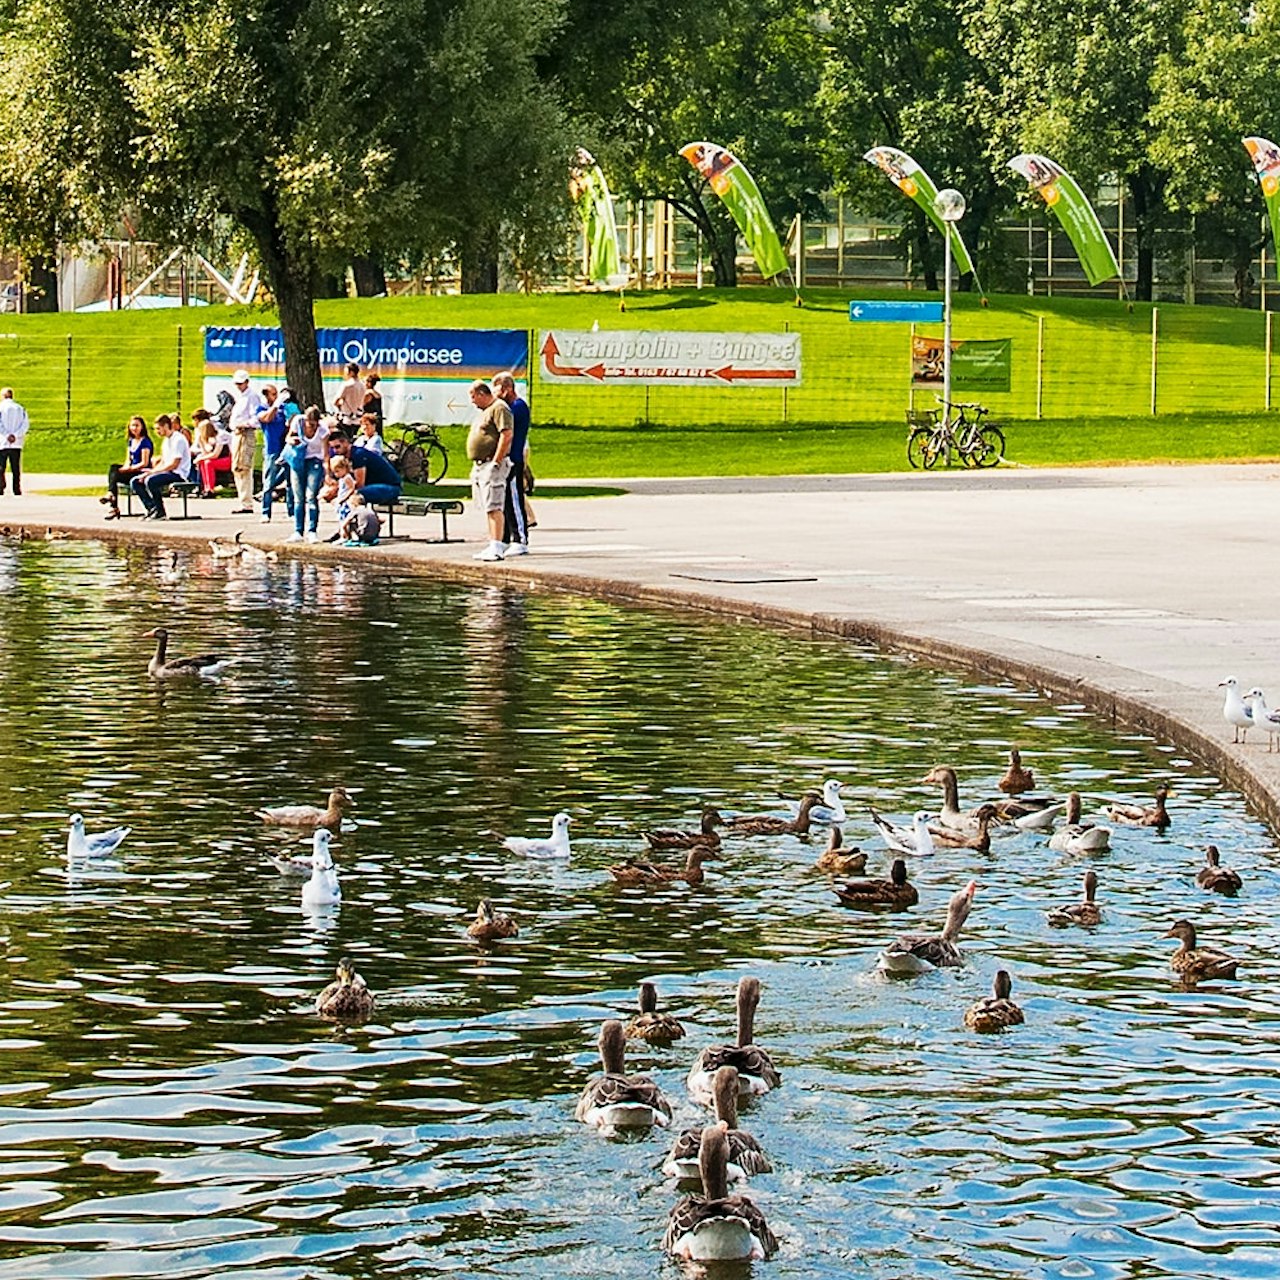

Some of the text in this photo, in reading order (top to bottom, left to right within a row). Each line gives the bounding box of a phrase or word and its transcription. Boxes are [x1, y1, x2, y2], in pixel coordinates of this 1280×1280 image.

[260, 339, 285, 362] Kin
[343, 338, 463, 369] Olympiasee
[564, 336, 796, 367] Trampolin + Bungee
